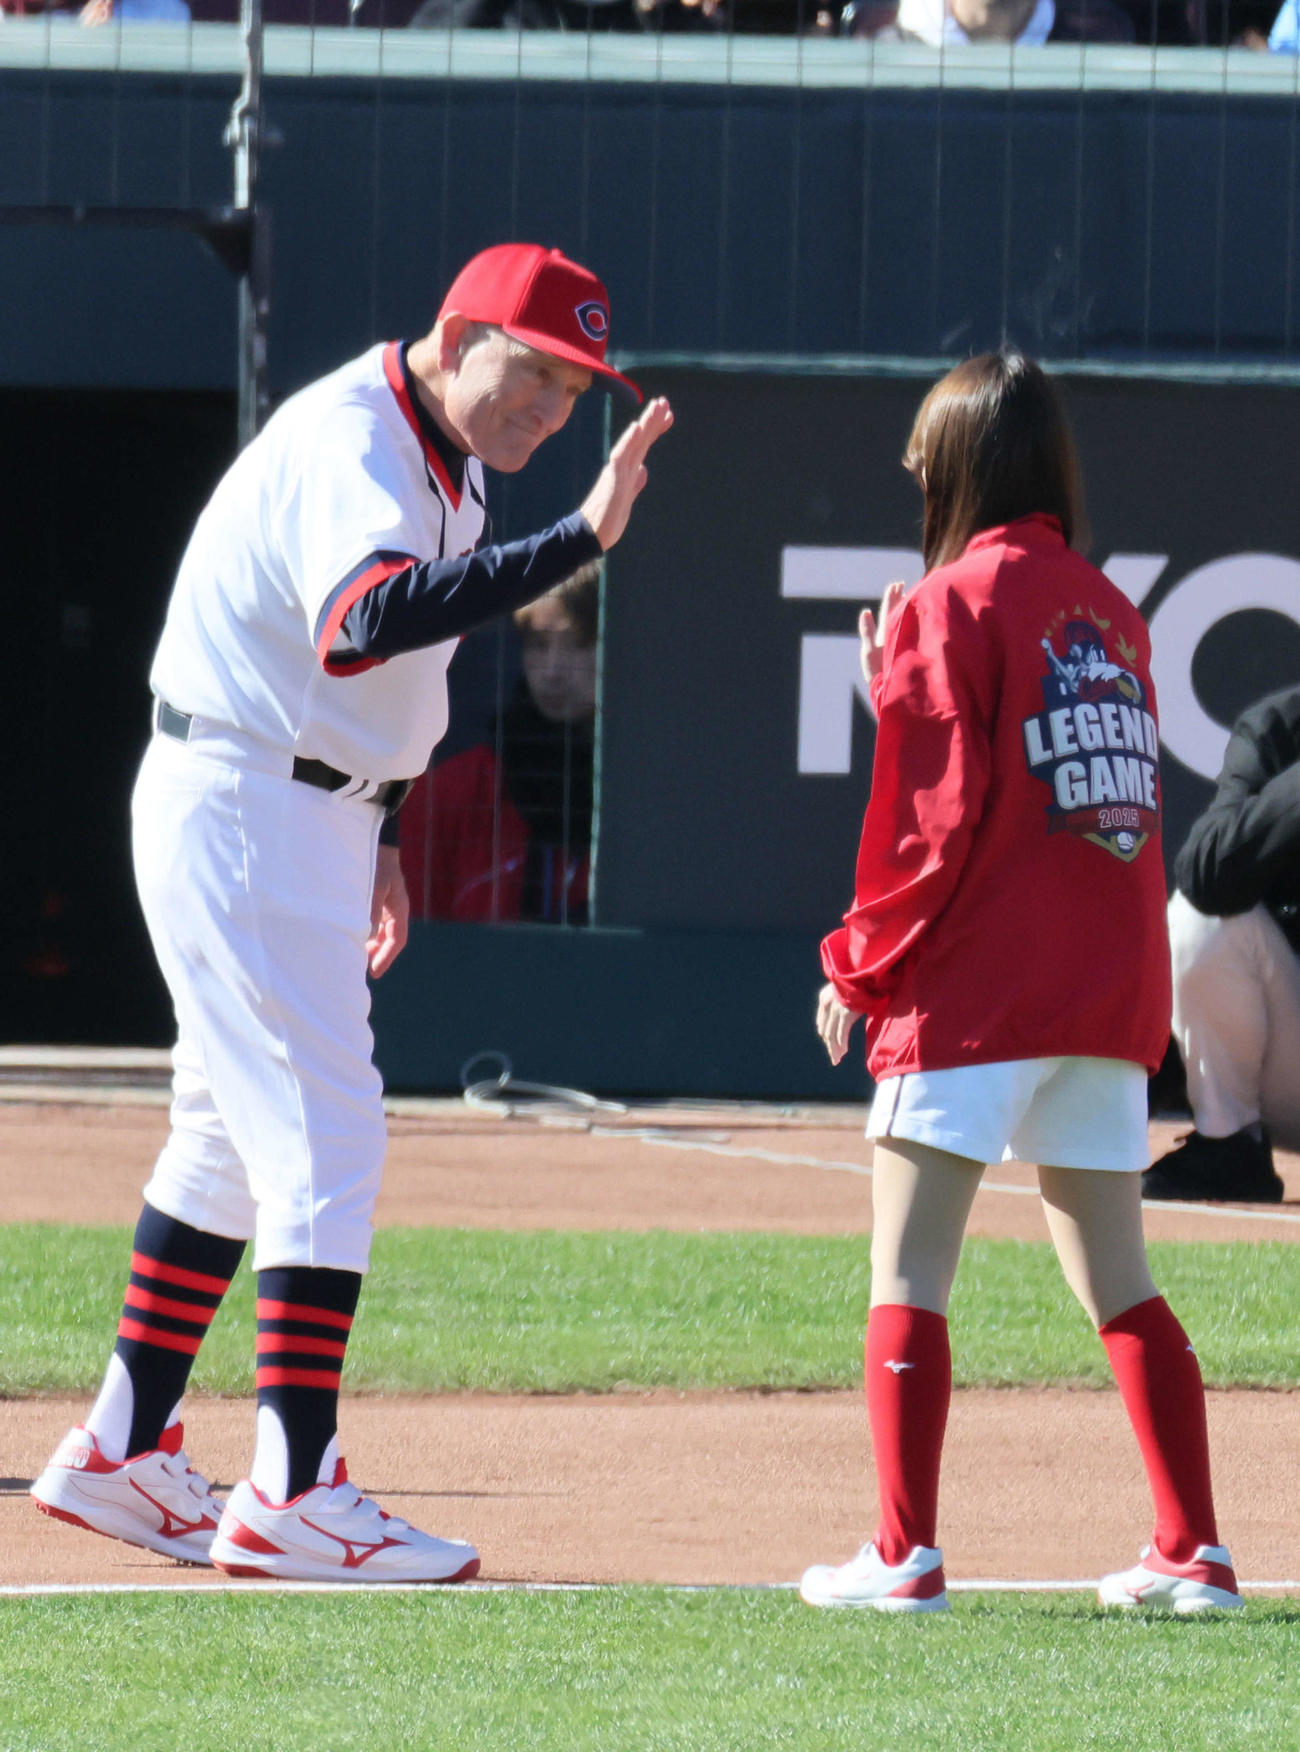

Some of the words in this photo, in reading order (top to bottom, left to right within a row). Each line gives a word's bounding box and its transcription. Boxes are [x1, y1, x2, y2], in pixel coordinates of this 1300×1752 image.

[1024, 702, 1158, 767] LEGEND
[1054, 755, 1157, 810] GAME
[1098, 808, 1140, 829] 2025
